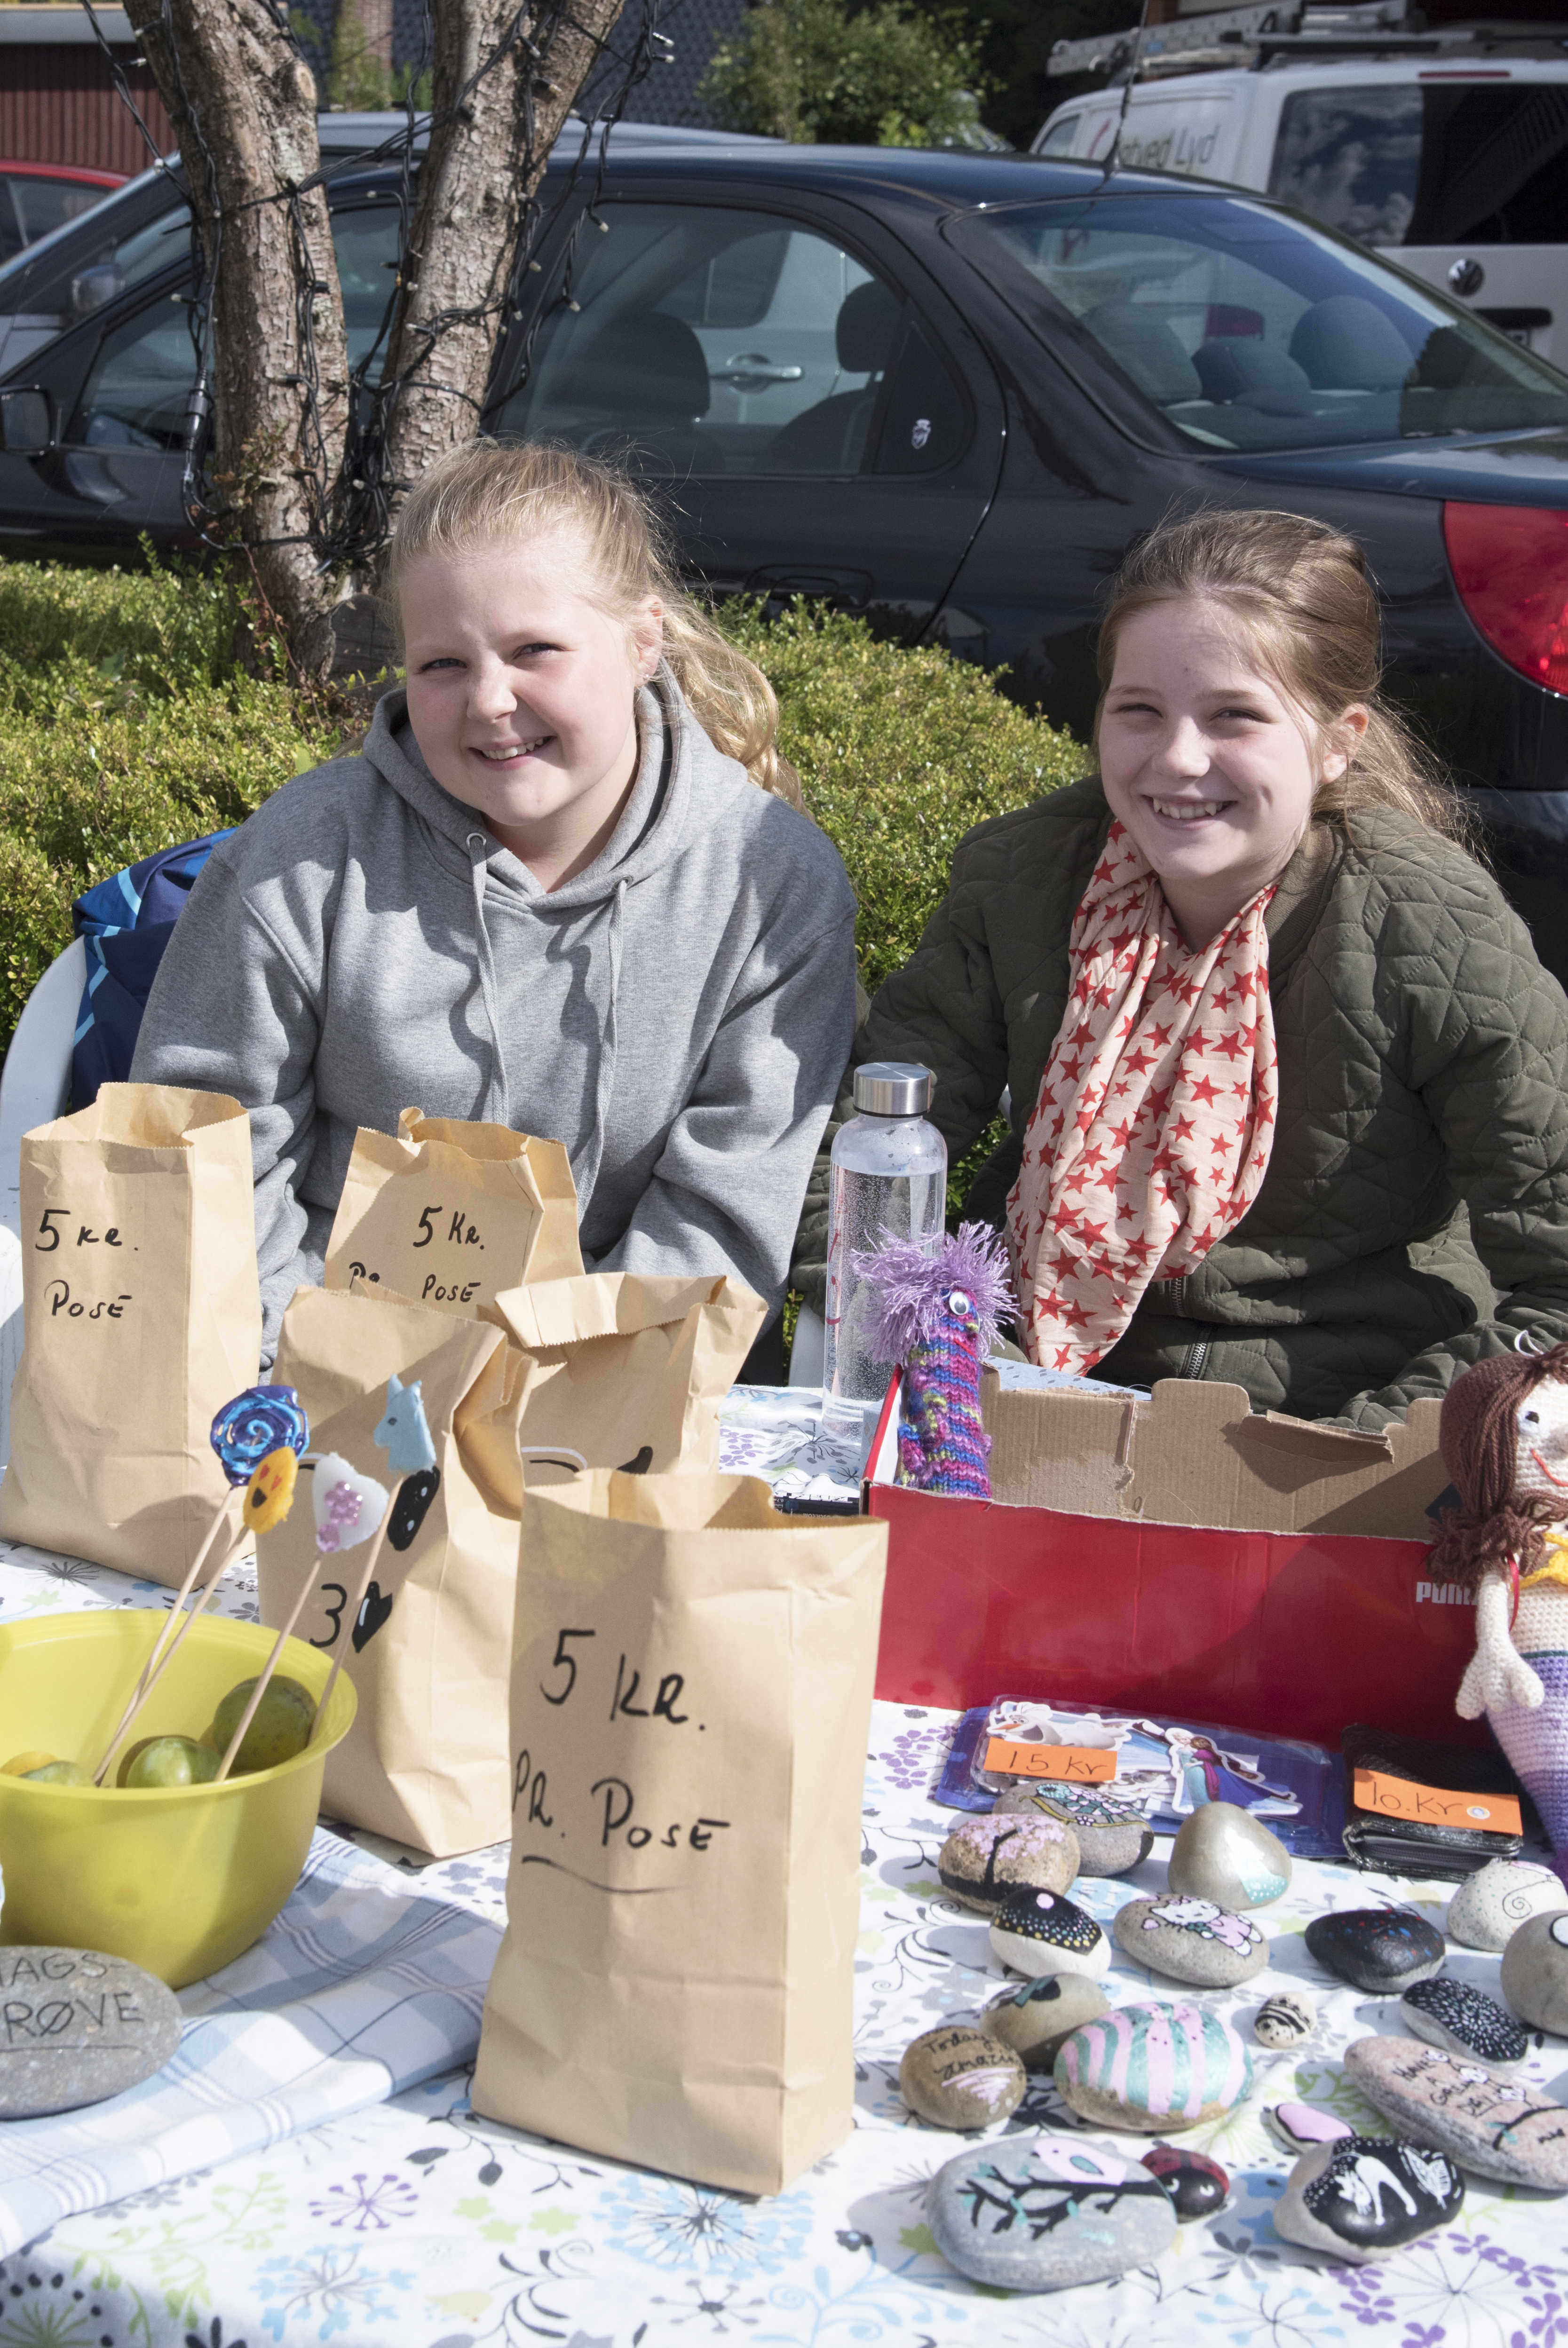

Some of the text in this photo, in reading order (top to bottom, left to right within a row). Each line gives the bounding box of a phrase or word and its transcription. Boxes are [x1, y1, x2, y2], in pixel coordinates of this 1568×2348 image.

[1176, 124, 1221, 173] Lyd
[35, 1209, 71, 1251] 5
[412, 1206, 443, 1248] 5
[539, 1628, 596, 1705] 5
[1009, 1750, 1050, 1772] 15
[0, 1953, 125, 1988] AGS-
